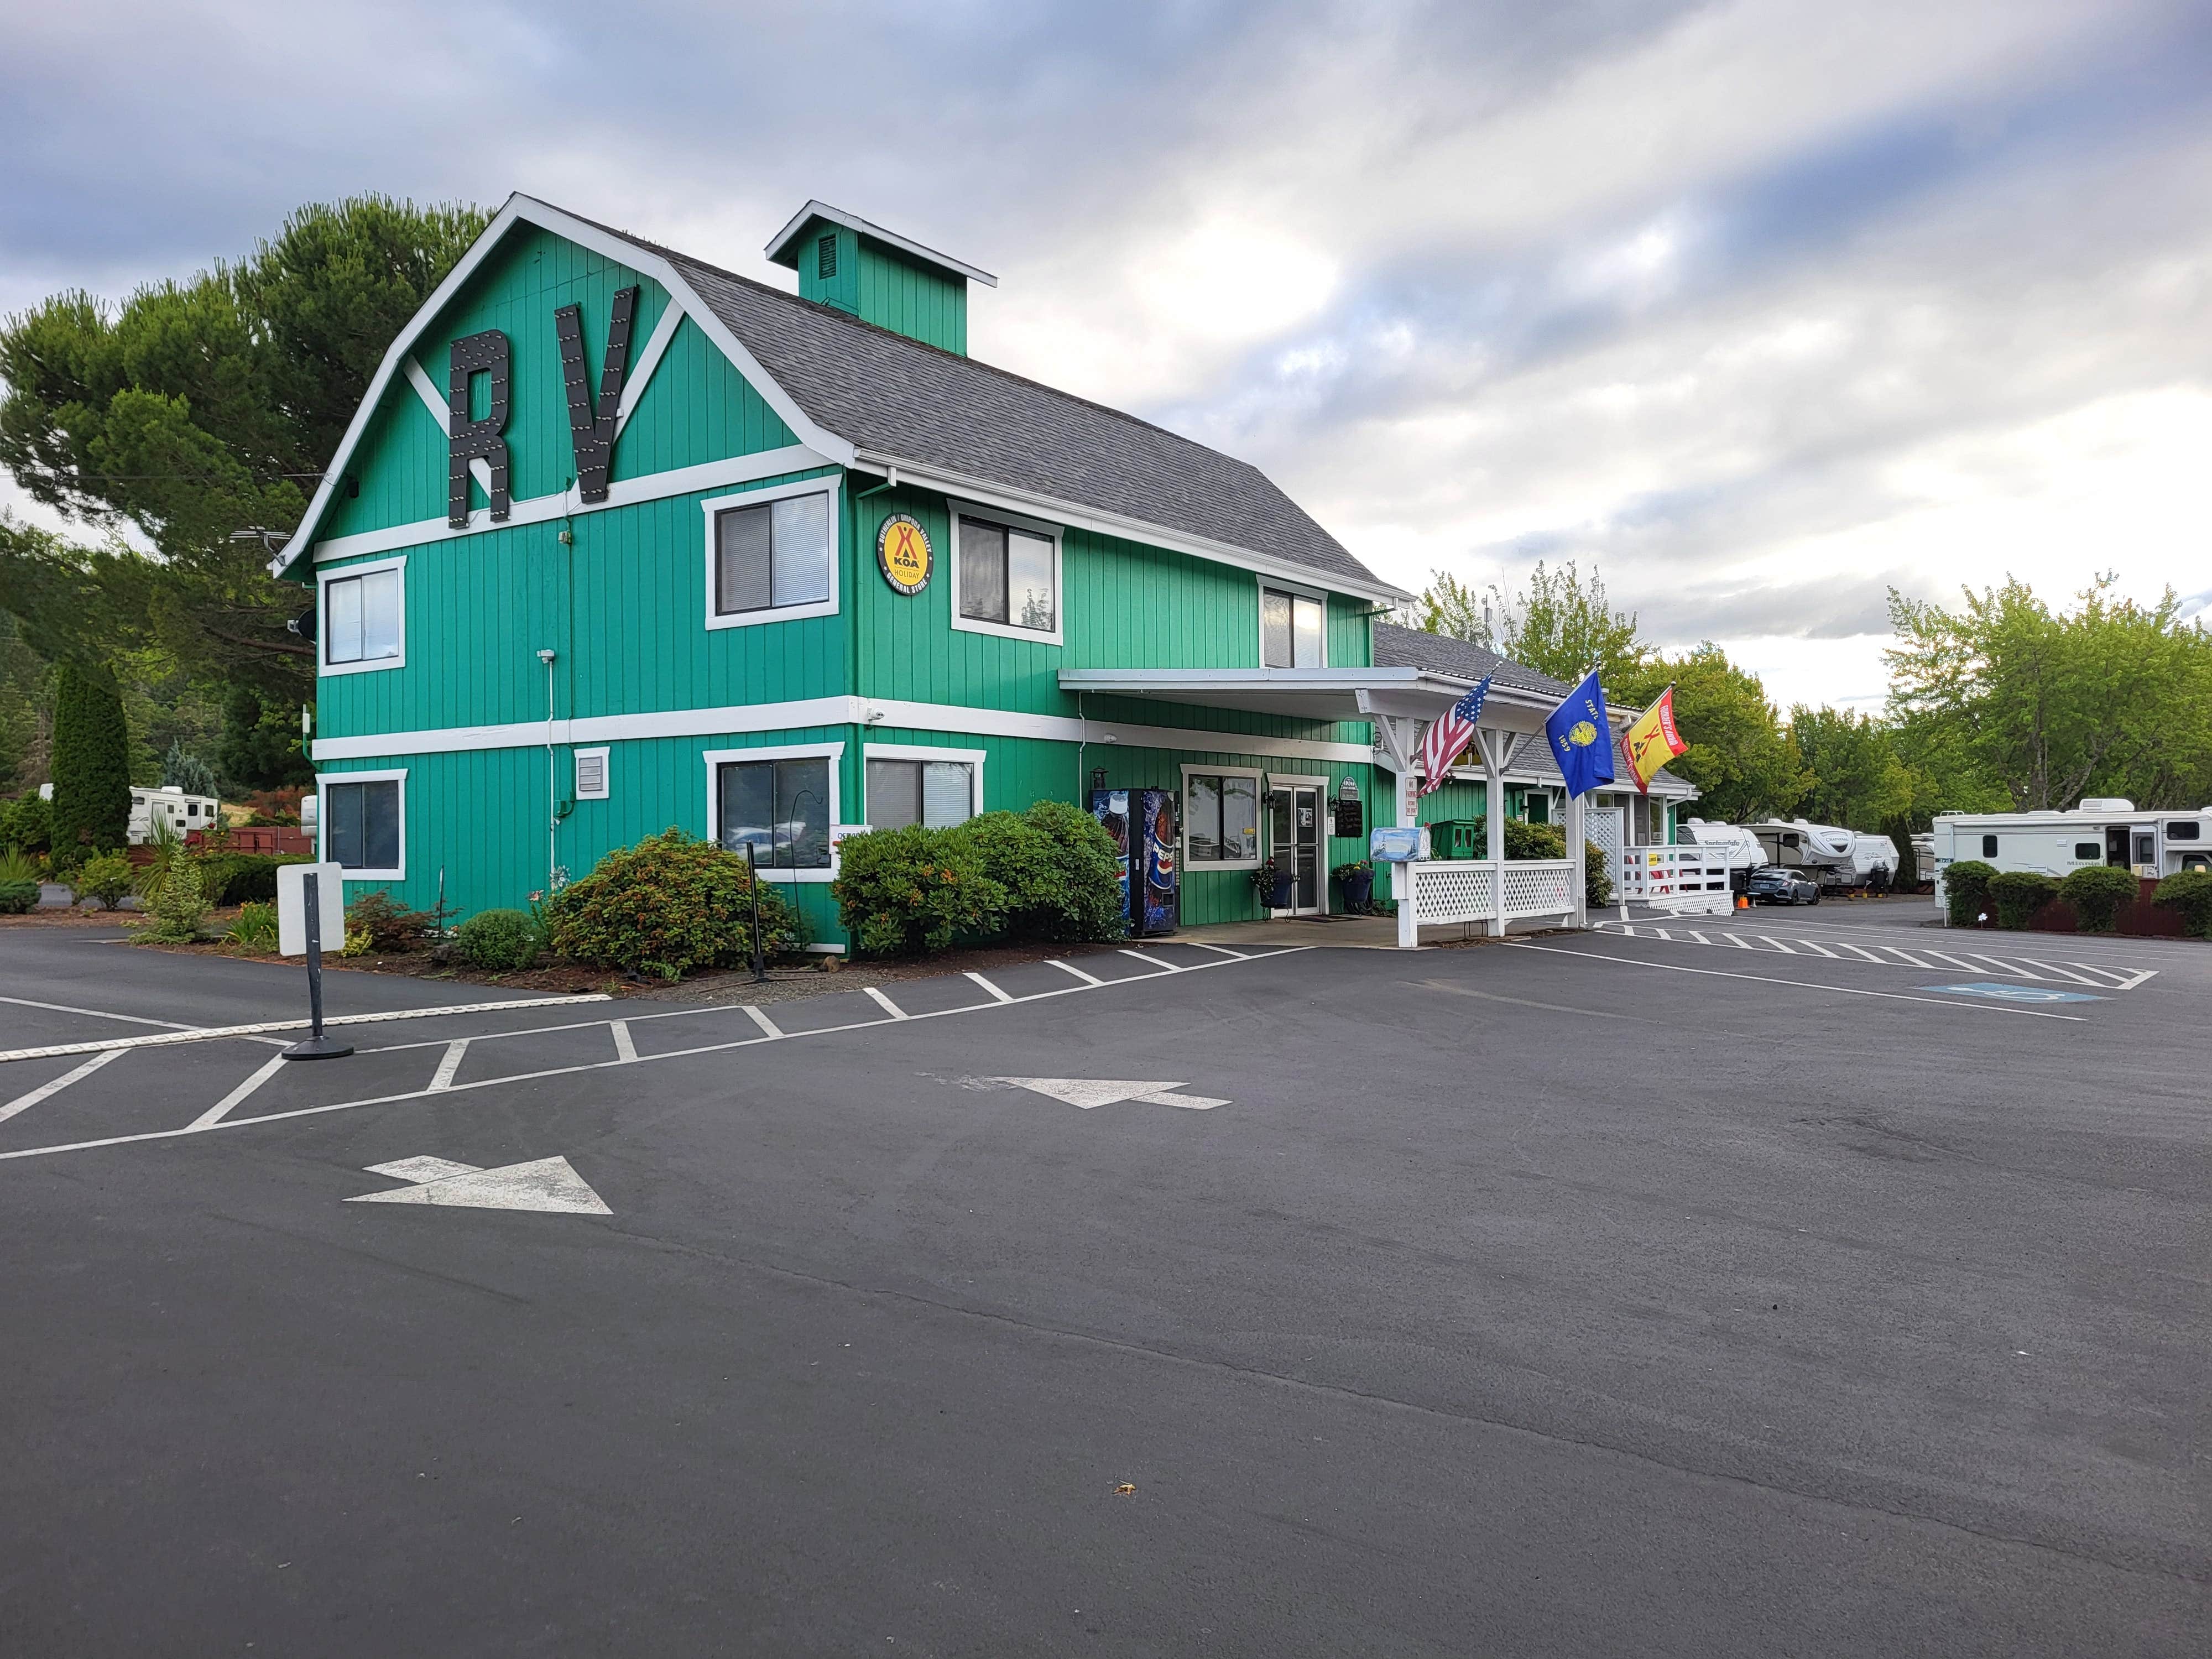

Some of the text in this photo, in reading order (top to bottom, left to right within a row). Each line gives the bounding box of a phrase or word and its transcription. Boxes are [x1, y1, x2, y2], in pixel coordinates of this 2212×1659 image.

[448, 284, 639, 529] RV
[879, 514, 897, 544] SUTHERLIN
[900, 514, 921, 530] UMPQUA
[920, 528, 932, 553] VALLEY
[894, 556, 920, 569] KOA
[886, 572, 928, 594] GENERAL STORE
[894, 569, 920, 579] HOLIDAY
[1558, 734, 1571, 752] 1859
[1153, 841, 1173, 863] PEPS
